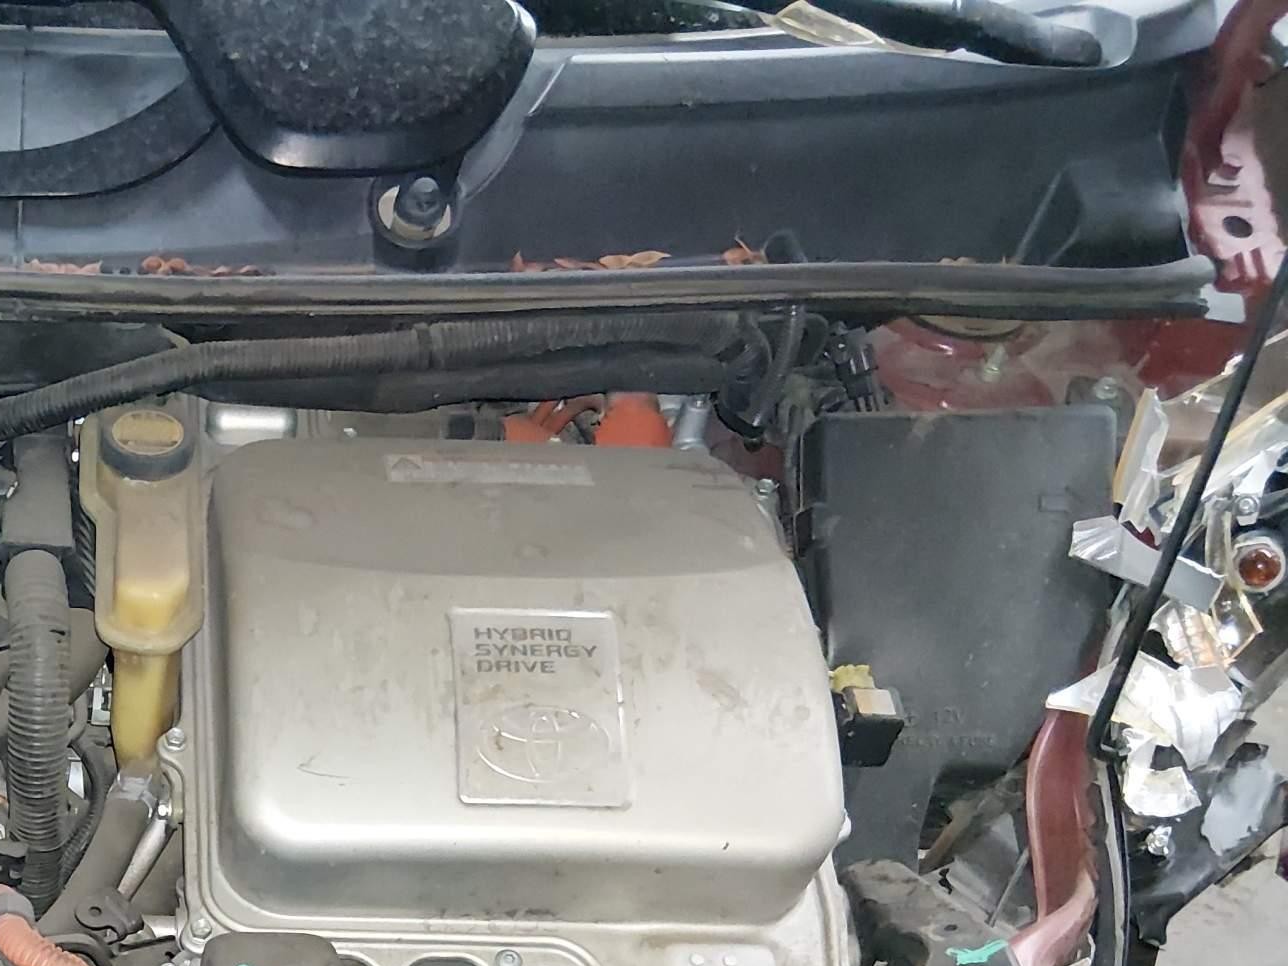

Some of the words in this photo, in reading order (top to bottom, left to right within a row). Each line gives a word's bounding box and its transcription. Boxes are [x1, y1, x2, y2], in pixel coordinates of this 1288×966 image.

[473, 626, 572, 642] HYBRID
[474, 643, 597, 658] SYNERGY
[476, 659, 556, 674] DRIVE
